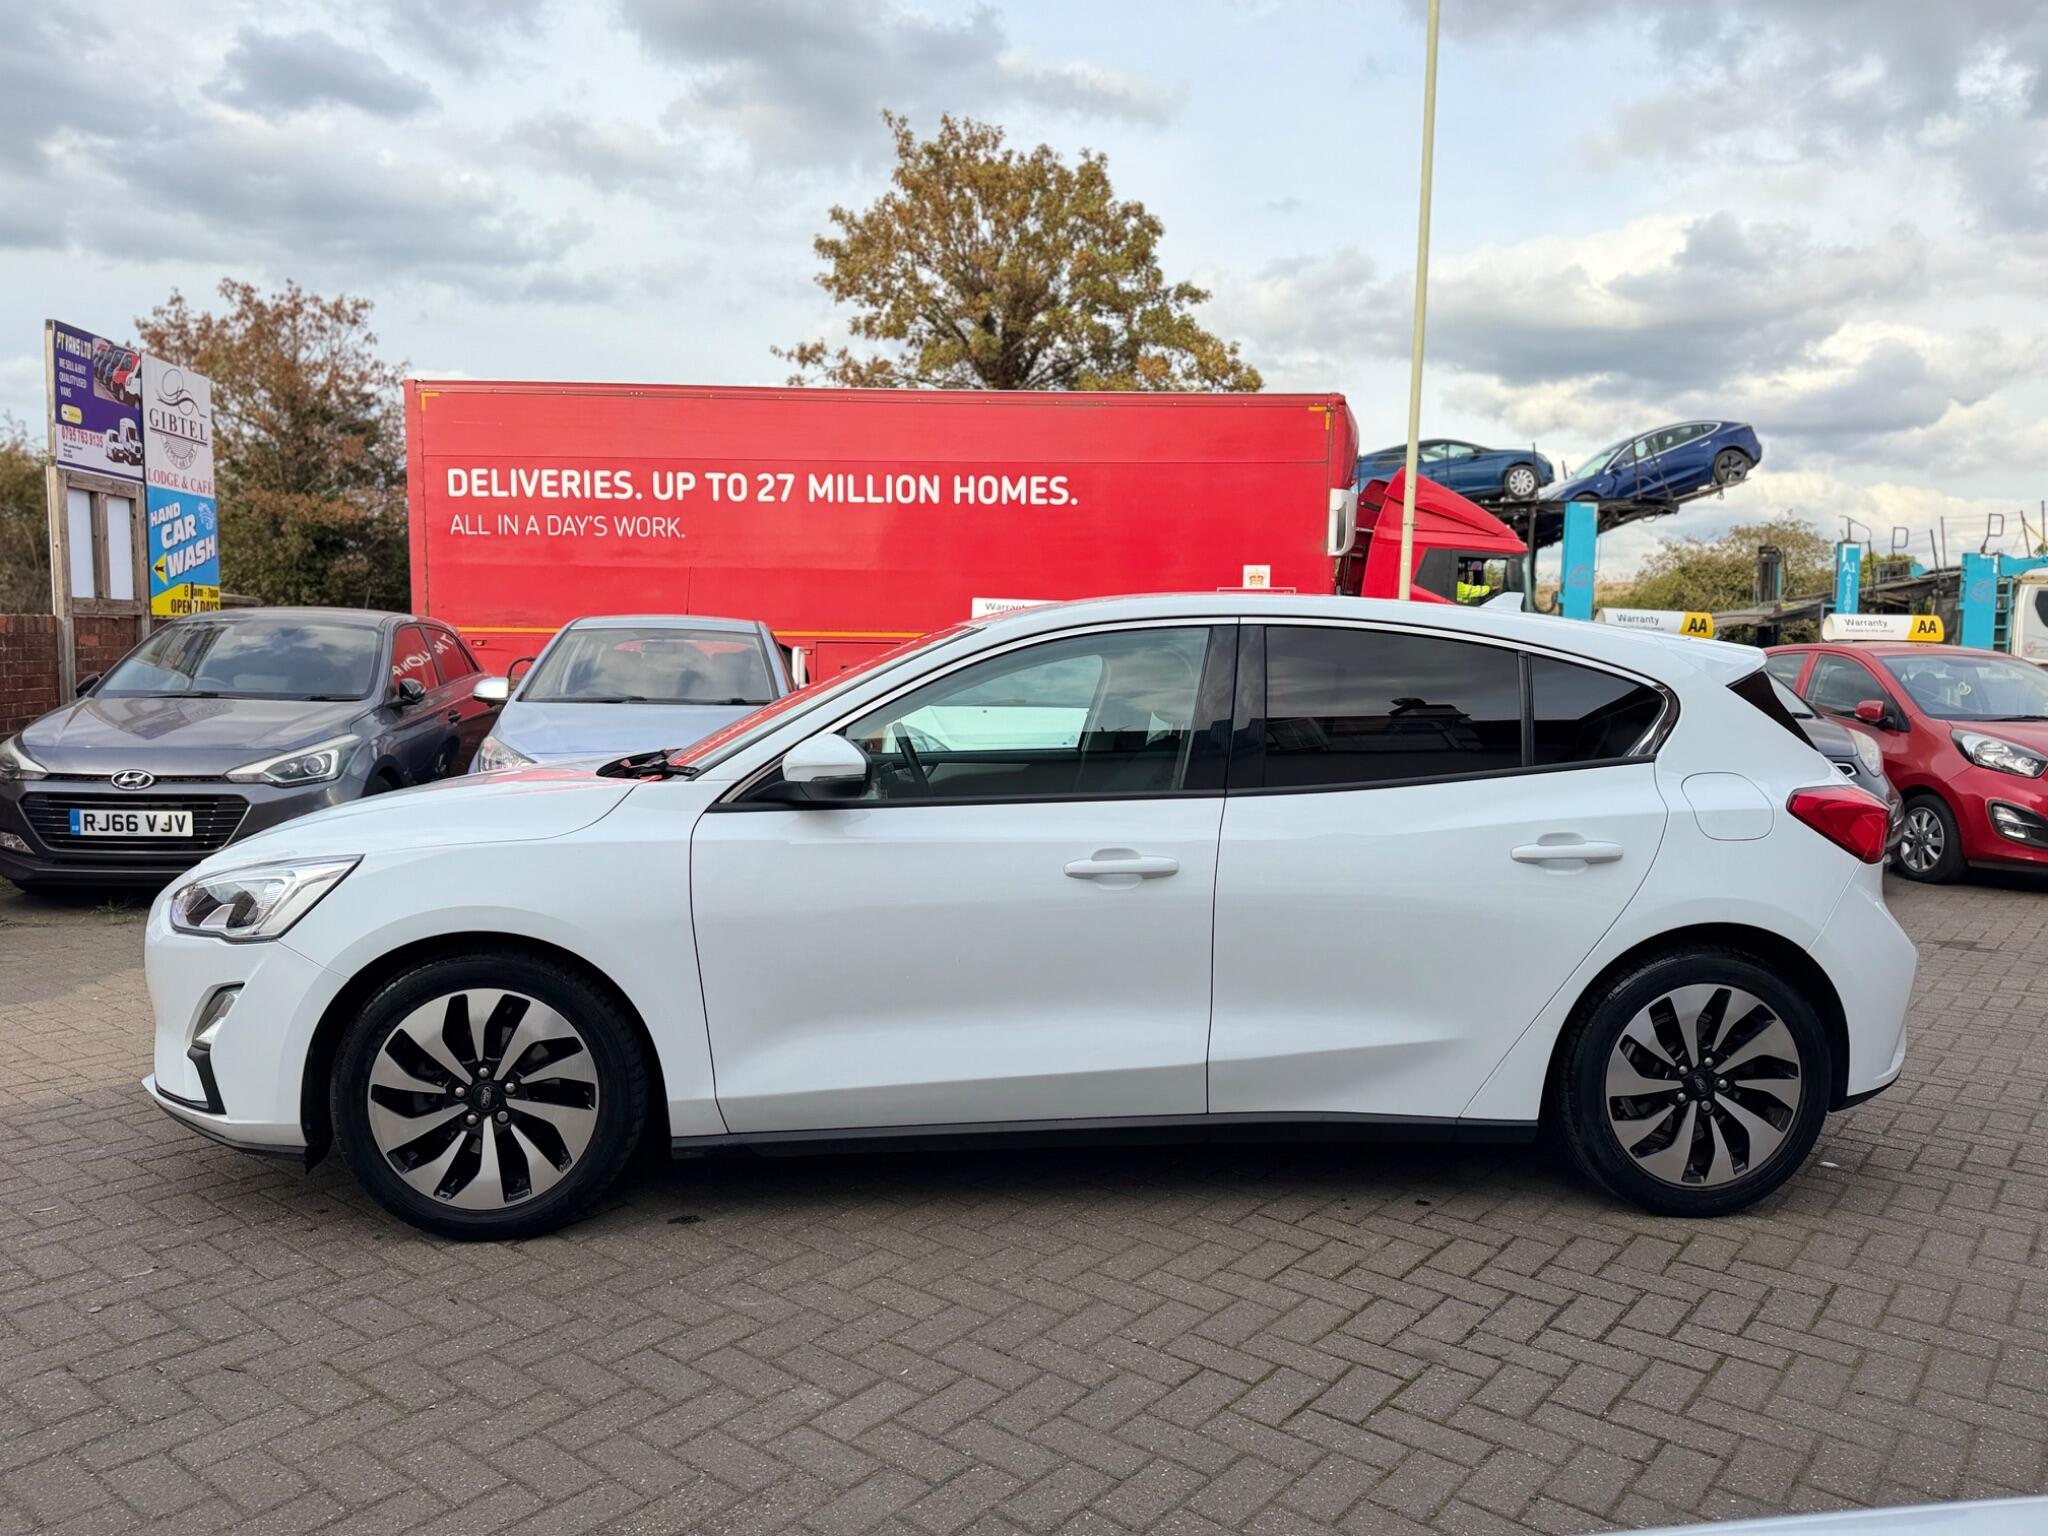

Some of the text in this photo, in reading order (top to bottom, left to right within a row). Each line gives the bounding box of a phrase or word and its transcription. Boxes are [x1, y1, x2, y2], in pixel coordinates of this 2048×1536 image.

[149, 407, 208, 441] GIBTEL
[147, 467, 179, 488] LODGE
[181, 475, 188, 489] &
[447, 468, 1079, 506] DELIVERIES. UP TO 27 MILLION HOMES.
[150, 502, 180, 528] HAND
[450, 514, 686, 539] ALL IN A DAY'S WORK.
[161, 514, 197, 549] CAR
[167, 534, 216, 578] WASH
[171, 598, 192, 614] OPEN
[193, 600, 199, 612] 7
[985, 602, 1025, 611] Warran
[1616, 614, 1707, 633] Warranty AA
[1844, 618, 1937, 634] Warranty AA
[83, 813, 186, 832] RJ66 VJV
